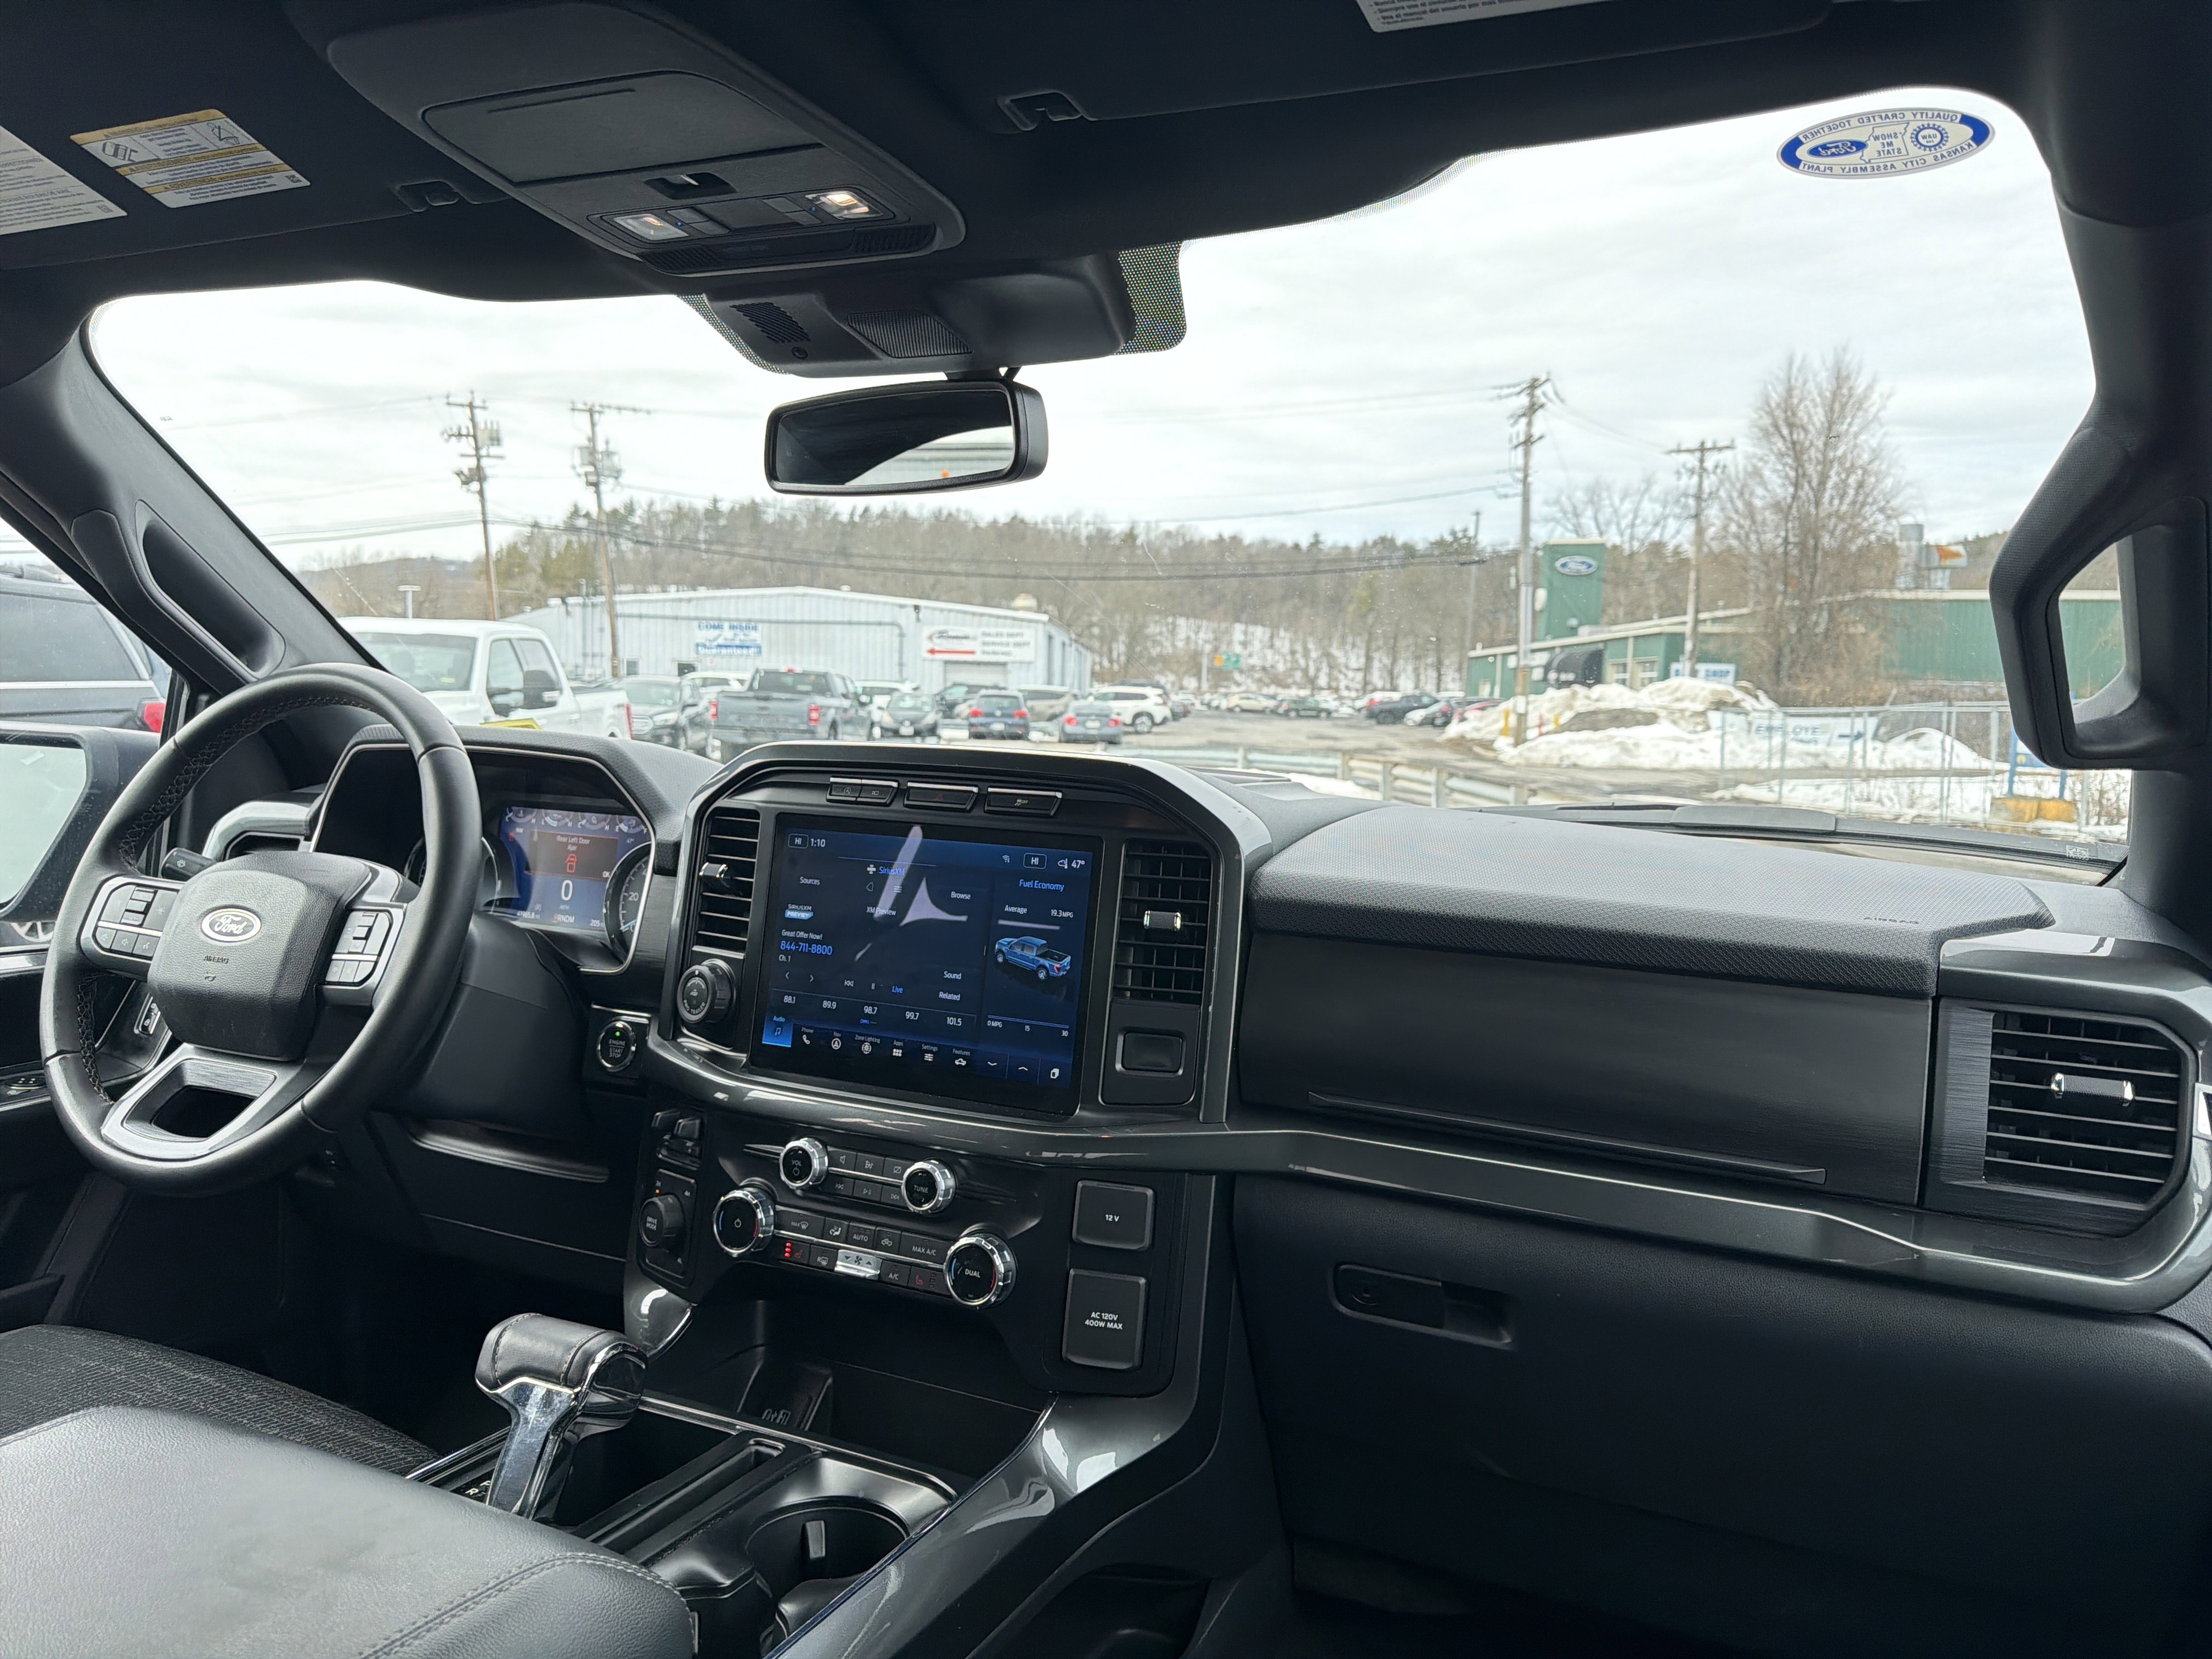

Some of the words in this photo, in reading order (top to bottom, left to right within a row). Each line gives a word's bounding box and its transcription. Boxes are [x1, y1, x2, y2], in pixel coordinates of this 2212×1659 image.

[810, 838, 826, 847] 1:10
[1031, 856, 1039, 865] HI
[1071, 860, 1085, 869] 47°
[879, 866, 905, 876] SiriusXM
[799, 877, 820, 885] Sources
[1019, 879, 1033, 888] Fuel
[1034, 881, 1065, 891] Economy
[561, 879, 573, 901] 0
[628, 892, 639, 901] 20
[951, 891, 971, 900] Browse
[876, 907, 896, 916] Preview
[1004, 905, 1028, 915] Average
[214, 915, 247, 935] Ford
[782, 929, 795, 938] Great
[796, 931, 808, 939] Offer
[809, 932, 823, 940] Now!
[780, 940, 833, 956] 844-711-8800
[944, 970, 962, 980] Sound
[892, 985, 904, 994] Live
[783, 995, 796, 1004] 88.1
[939, 991, 961, 1001] Related
[822, 1000, 837, 1009] 89.9
[864, 1006, 878, 1014] 98.7
[905, 1011, 919, 1020] 99.7
[946, 1017, 962, 1026] 101.5
[865, 1035, 881, 1044] Lighting
[921, 1043, 938, 1052] Settings
[952, 1048, 970, 1056] Features
[913, 1184, 929, 1194] TUNE
[646, 1215, 658, 1224] DRIVE
[646, 1222, 657, 1231] MODE
[853, 1233, 868, 1242] AUTO
[912, 1245, 924, 1254] MAX
[926, 1248, 936, 1256] A/C
[888, 1272, 899, 1281] A/C
[965, 1268, 981, 1278] DUAL
[1090, 1311, 1101, 1319] AC
[1102, 1313, 1118, 1321] 120V
[1085, 1319, 1105, 1328] 400W
[1107, 1322, 1123, 1330] MAX
